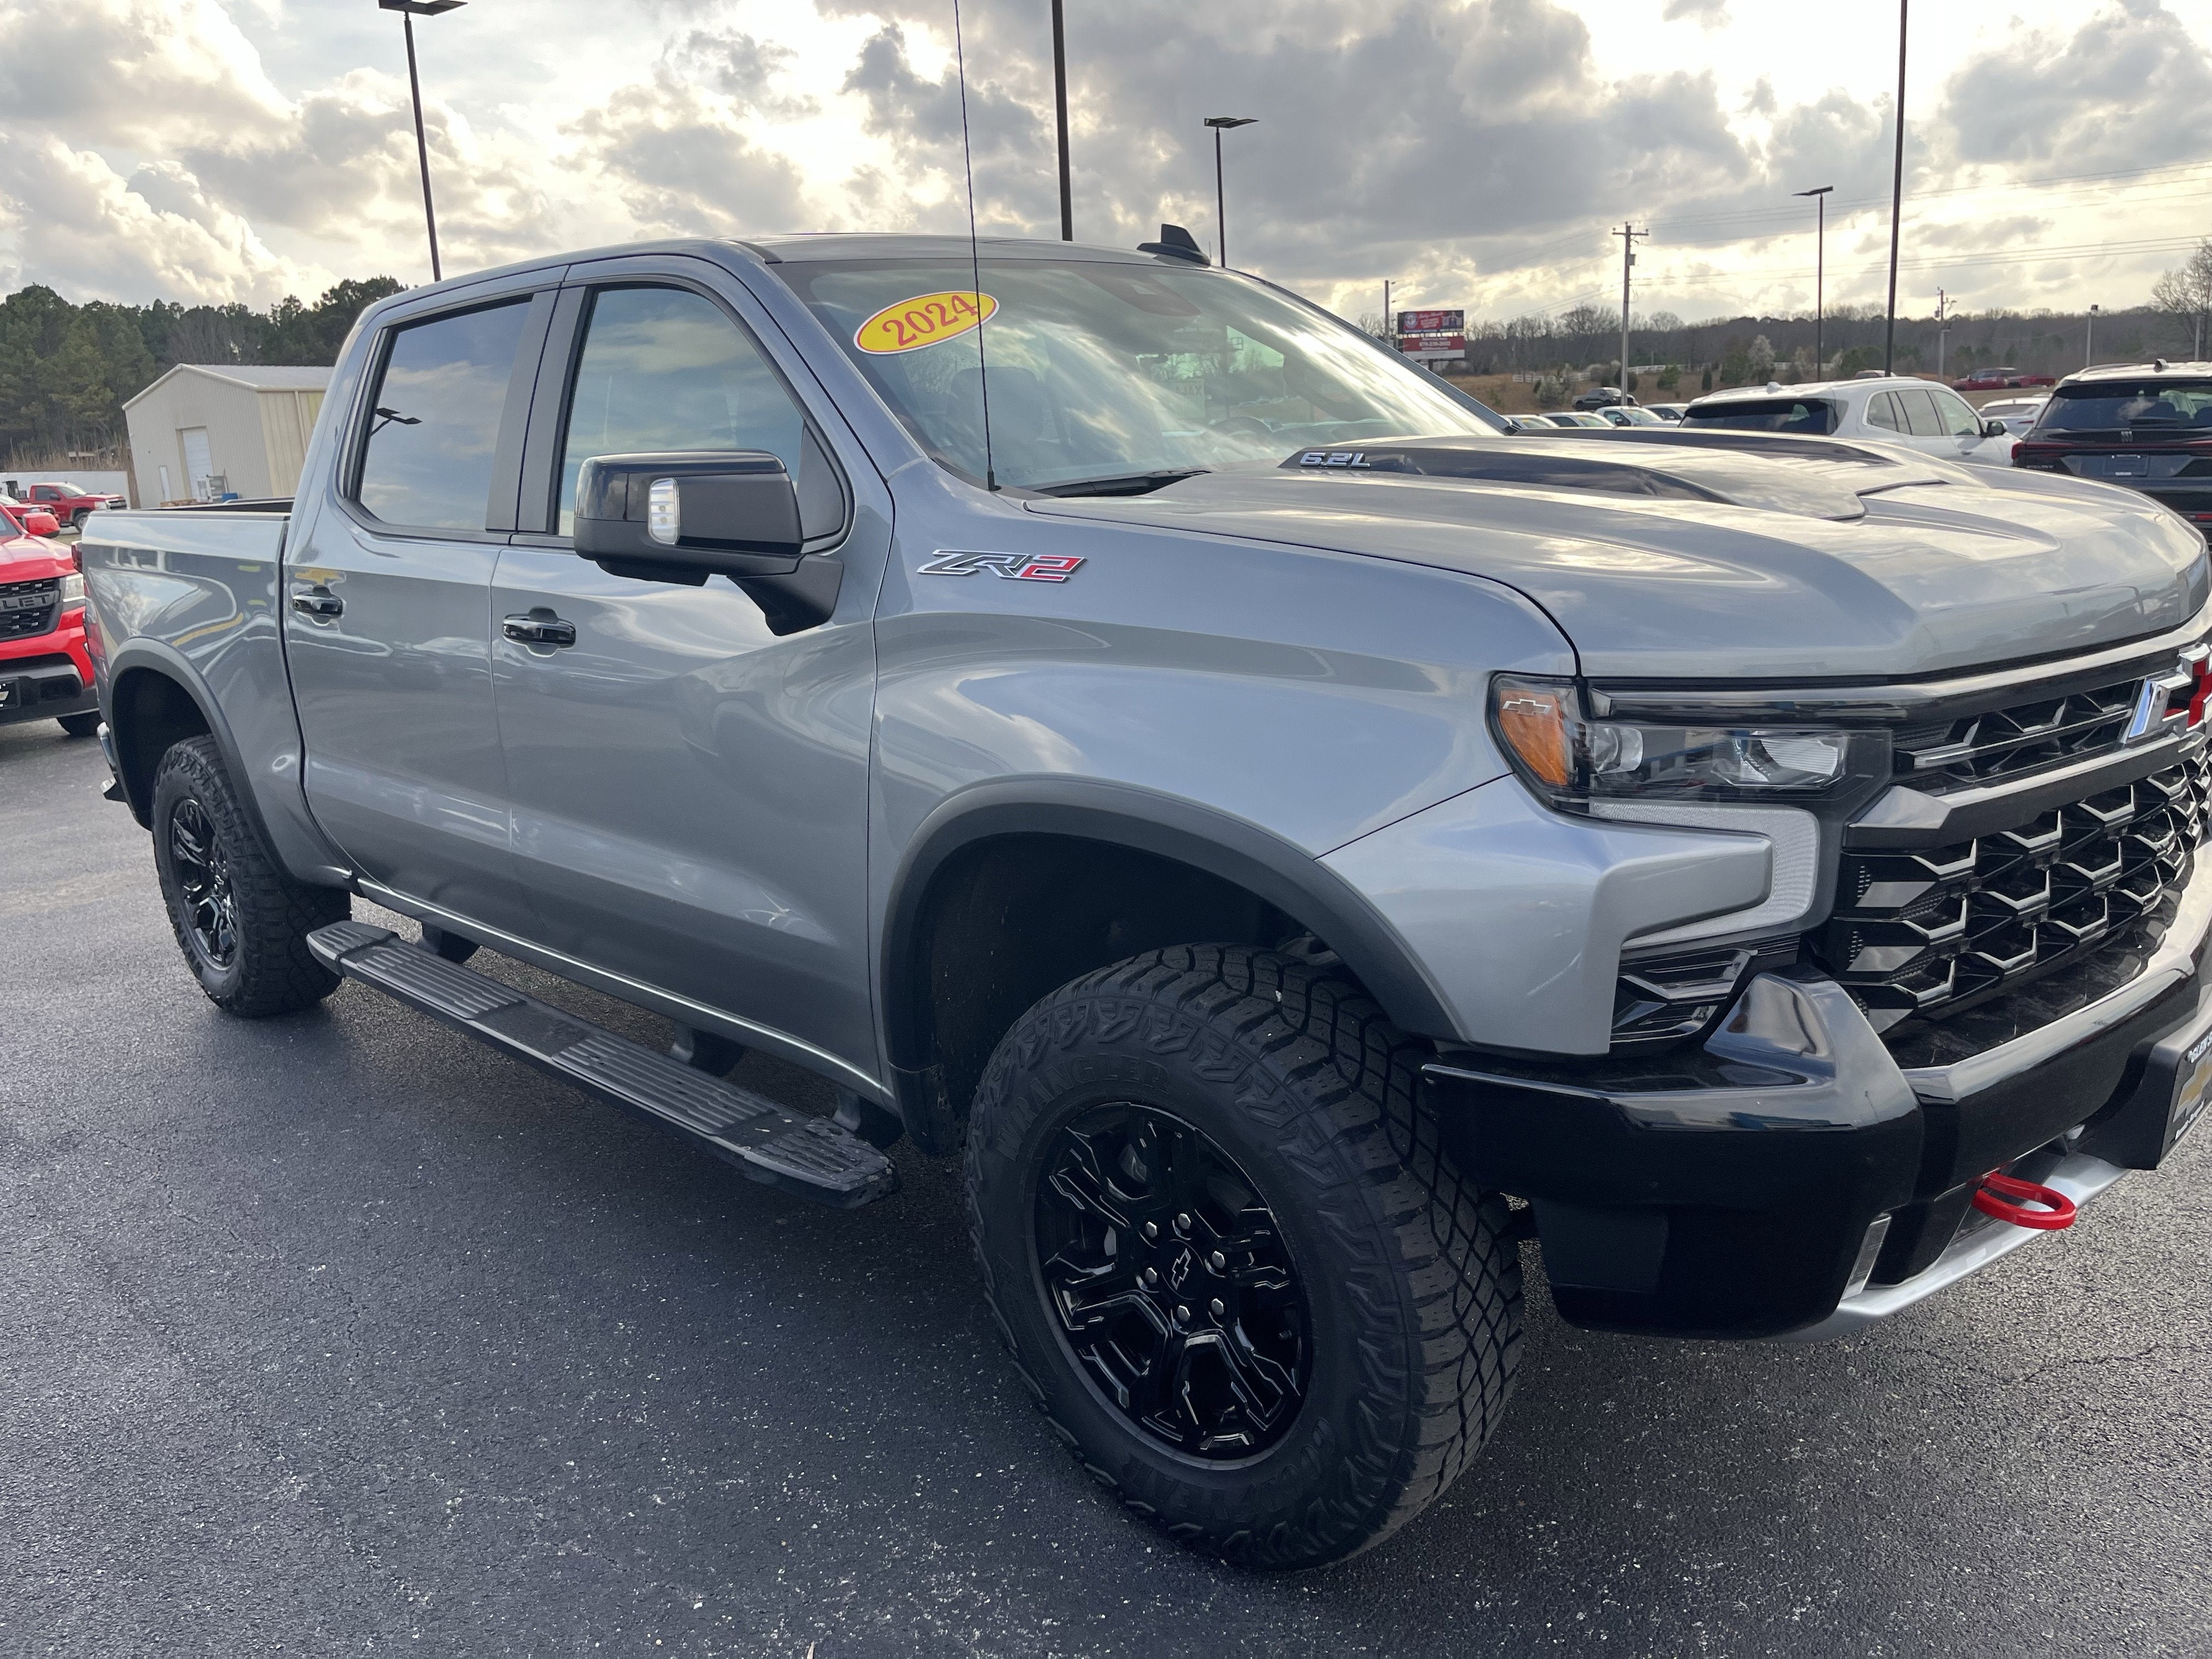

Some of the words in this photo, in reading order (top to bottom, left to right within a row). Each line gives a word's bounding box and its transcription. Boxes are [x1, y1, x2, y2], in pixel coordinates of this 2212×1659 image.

[882, 295, 979, 347] 2024
[1299, 452, 1370, 468] 6.2L
[917, 549, 1088, 583] ZR2
[0, 594, 50, 611] LET
[996, 1052, 1170, 1163] WRANGLER
